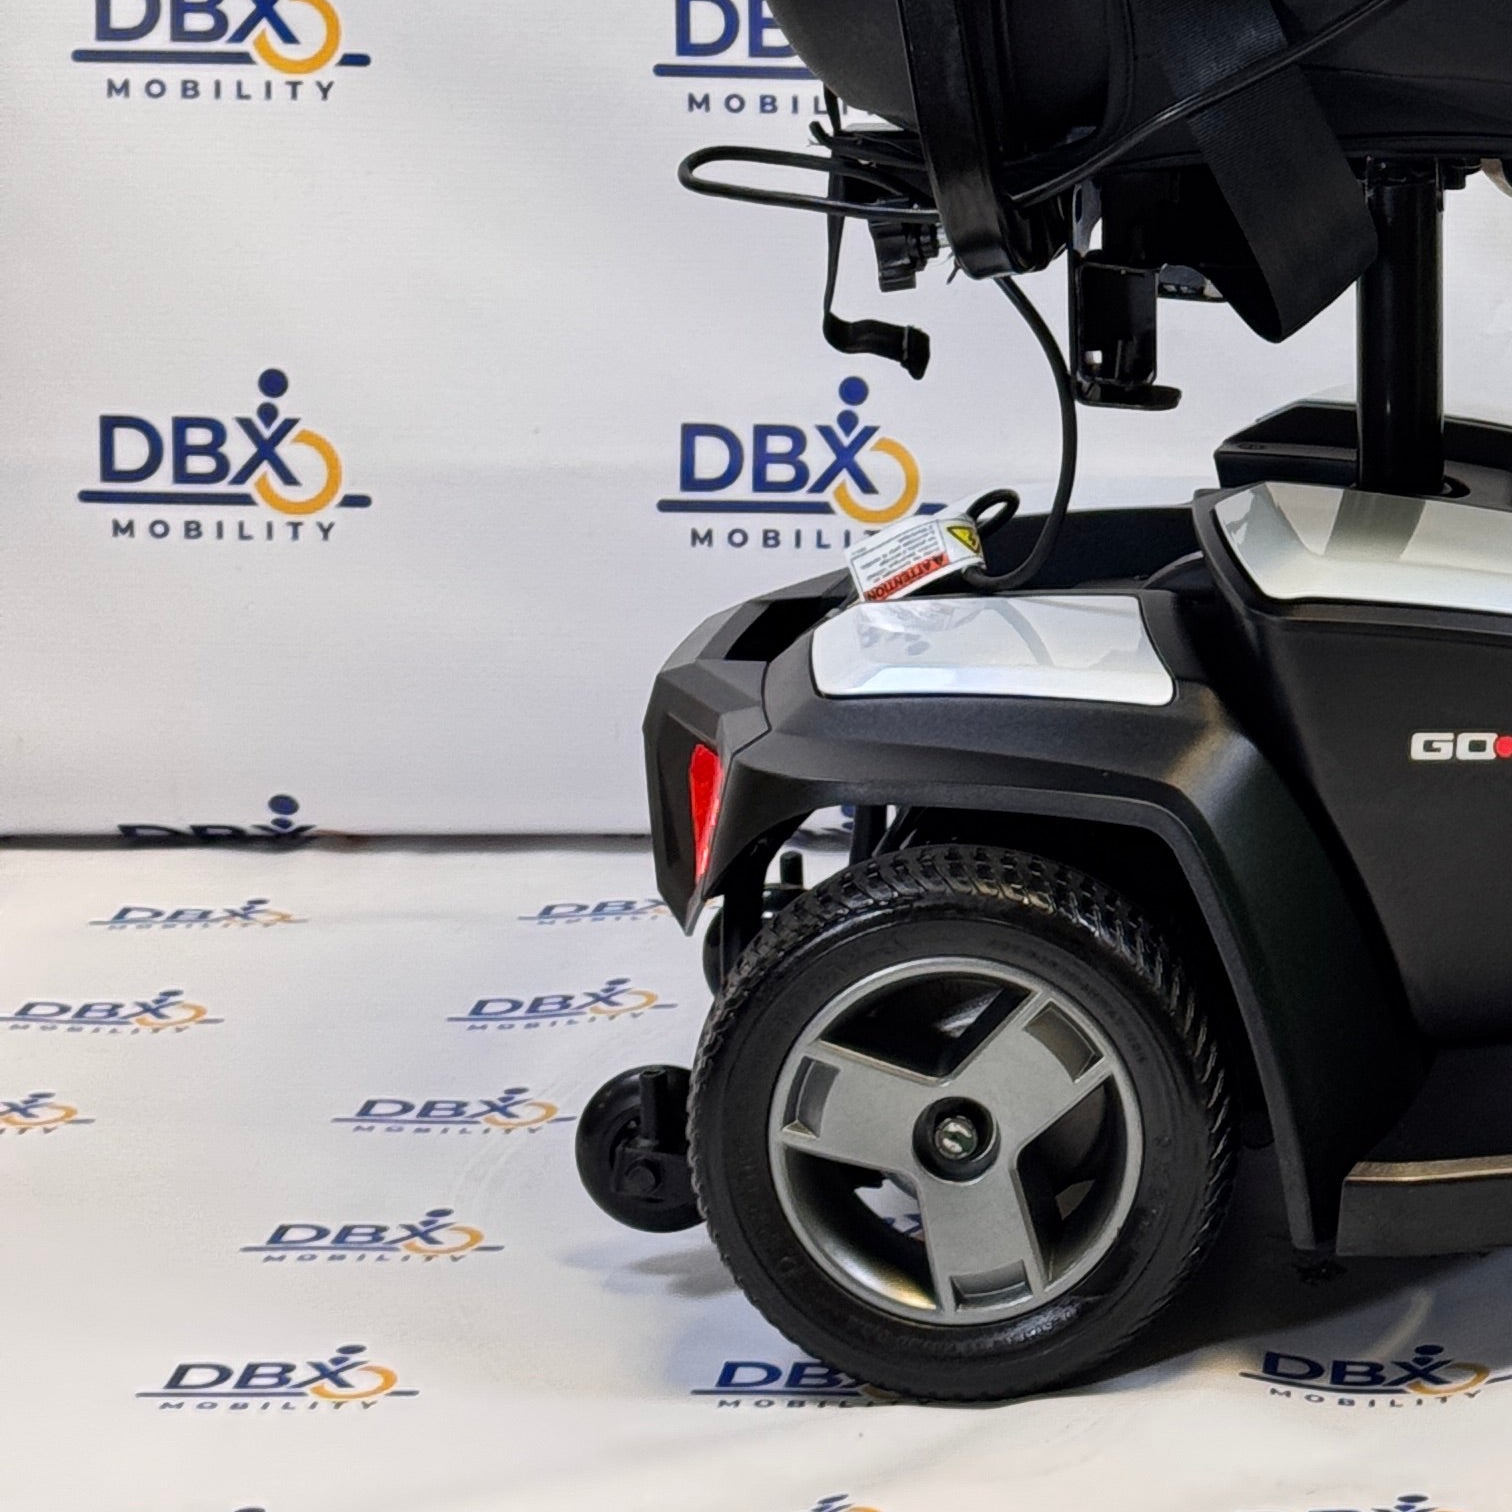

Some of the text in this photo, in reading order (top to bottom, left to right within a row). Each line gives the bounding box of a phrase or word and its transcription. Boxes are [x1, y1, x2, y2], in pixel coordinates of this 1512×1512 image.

[107, 79, 334, 103] MOBILITY
[687, 92, 874, 115] MOBILI
[99, 415, 300, 486] DBX
[679, 423, 879, 495] DBX
[112, 519, 336, 542] MOBILITY
[690, 529, 881, 549] MOBILI
[15, 1001, 185, 1019] DBX
[469, 988, 633, 1016] DBX
[355, 1098, 532, 1119] DBX
[265, 1222, 456, 1245] DBX
[163, 1361, 368, 1391] DBX
[715, 1361, 856, 1389] DB
[1262, 1351, 1454, 1386] DBX
[1270, 1388, 1481, 1408] MOBILITY
